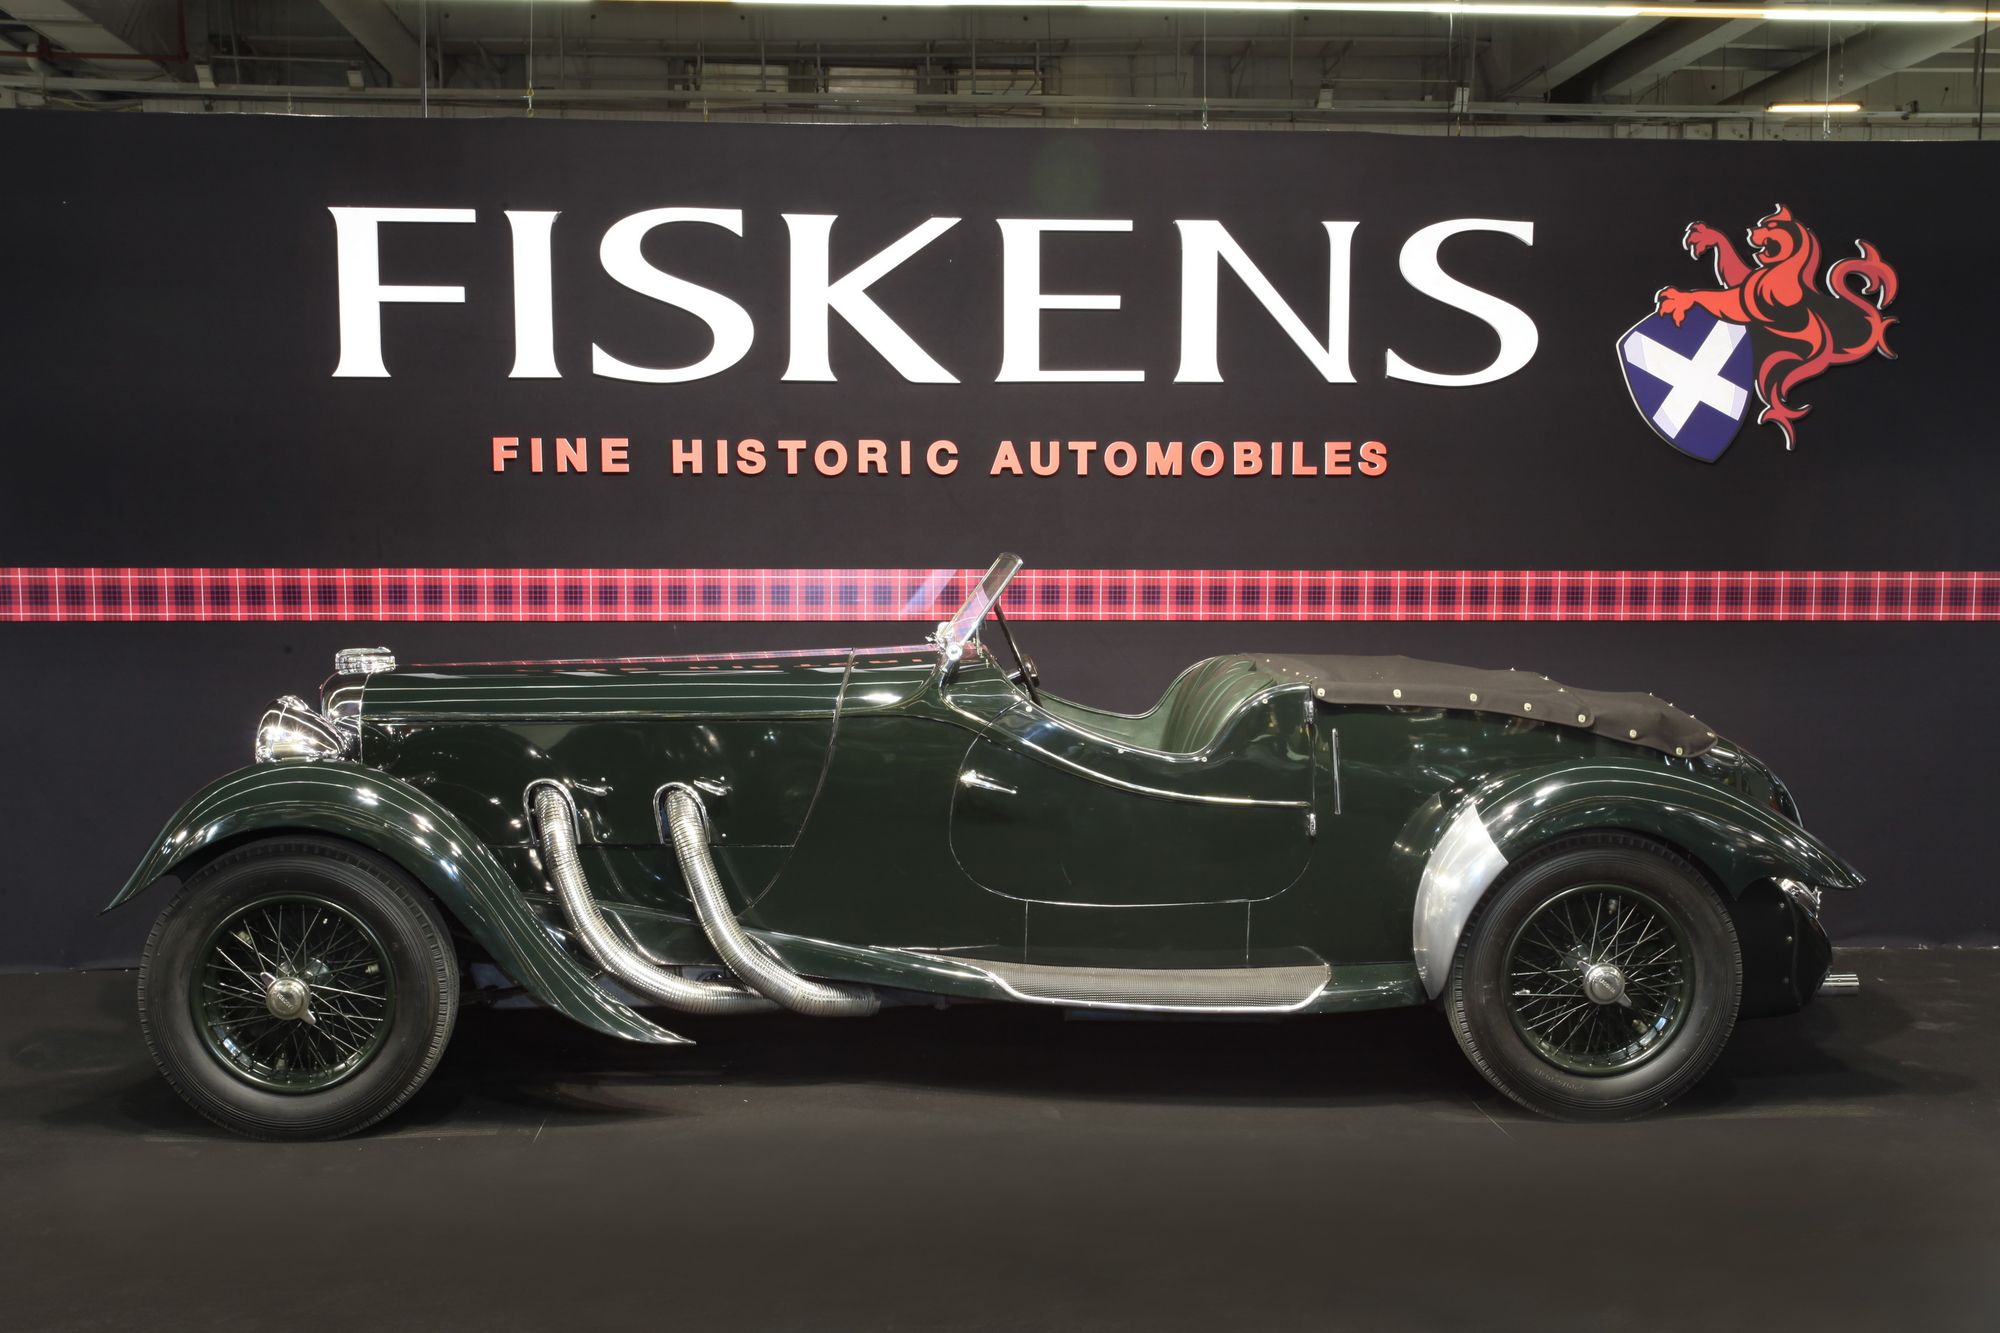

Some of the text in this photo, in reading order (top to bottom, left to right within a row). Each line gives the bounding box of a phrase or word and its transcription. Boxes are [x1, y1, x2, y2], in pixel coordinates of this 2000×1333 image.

[328, 206, 1539, 387] FISKENS
[492, 436, 1388, 478] FINE HISTORIC AUTOMOBILES
